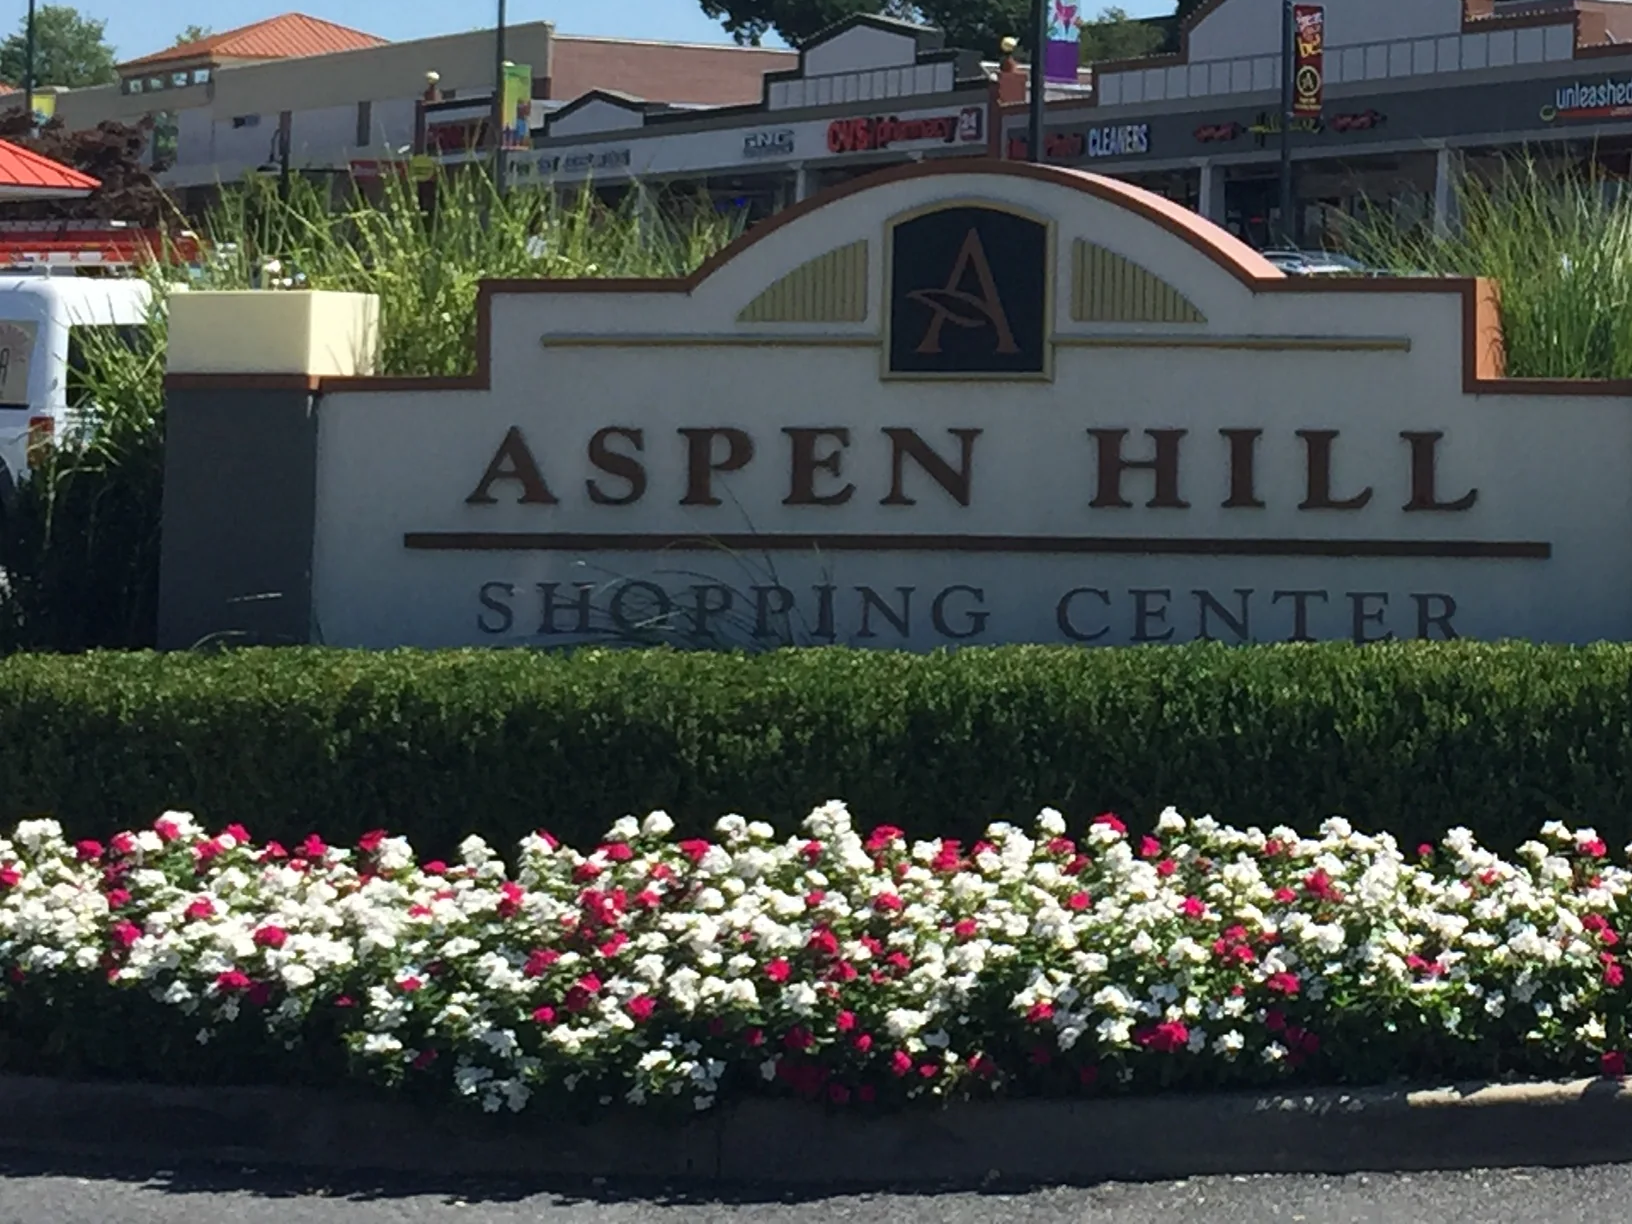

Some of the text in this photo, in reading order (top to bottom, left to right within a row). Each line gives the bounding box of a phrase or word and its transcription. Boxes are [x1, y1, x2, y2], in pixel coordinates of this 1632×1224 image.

[1088, 124, 1149, 157] CLEANERS
[463, 425, 1479, 512] ASPEN HILL
[476, 580, 1460, 646] SHOPPING CENTER
